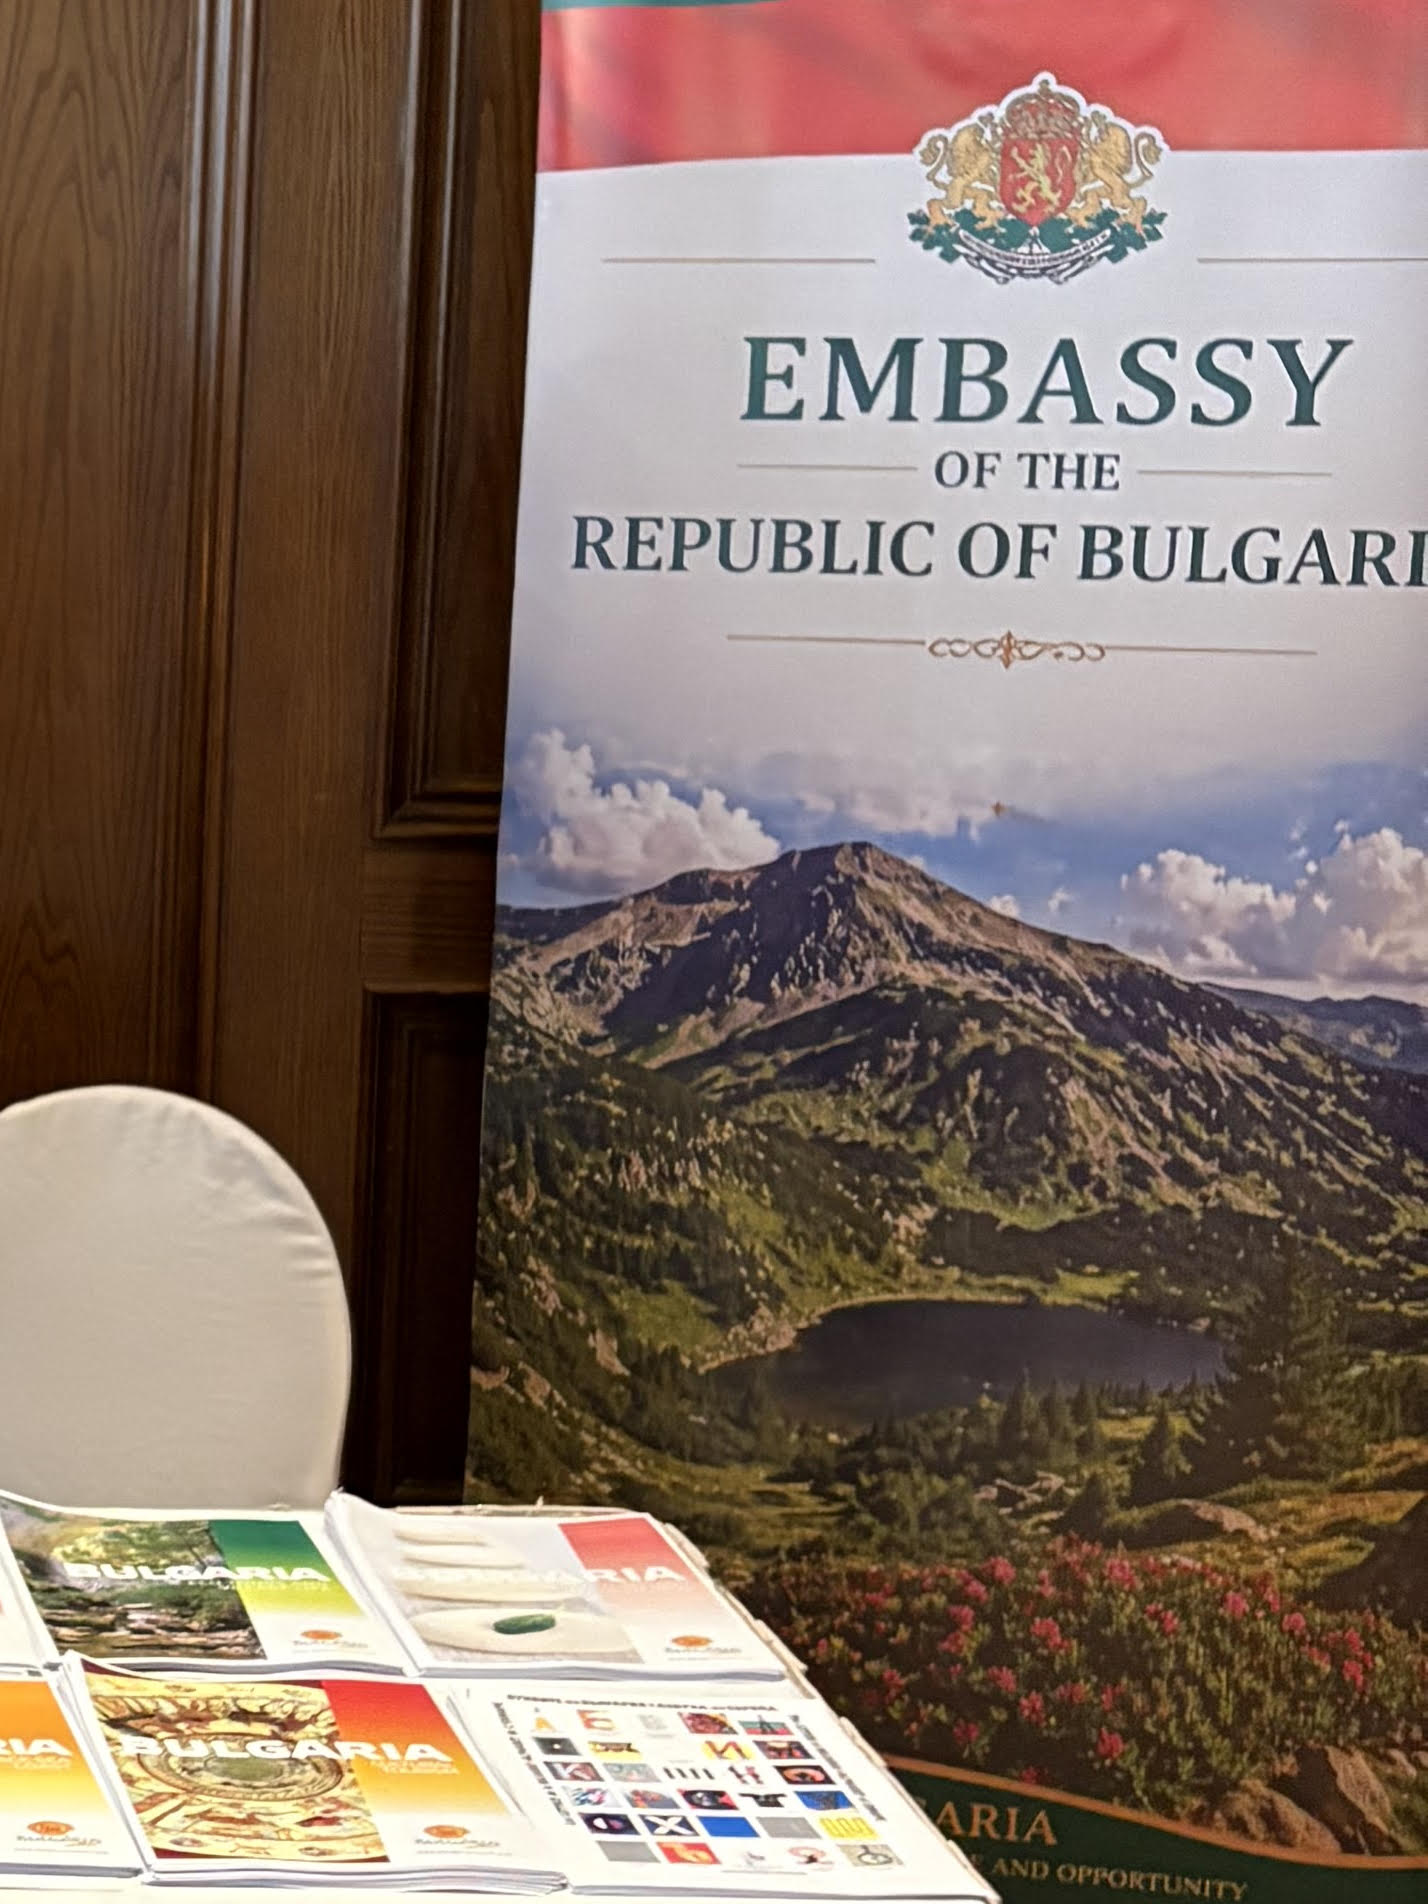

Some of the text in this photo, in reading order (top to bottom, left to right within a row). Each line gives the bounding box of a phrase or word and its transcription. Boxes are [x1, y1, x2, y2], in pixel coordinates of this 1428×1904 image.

[739, 335, 1355, 428] EMBASSY
[934, 451, 1122, 492] OF THE
[571, 516, 1428, 587] REPUBLIC OF BULGARI
[64, 1562, 332, 1581] BULGARIA
[119, 1734, 453, 1762] BULGARIA
[915, 1799, 1059, 1846] ARIA
[992, 1856, 1049, 1881] AND
[1056, 1862, 1249, 1902] OPPORTUNITY
